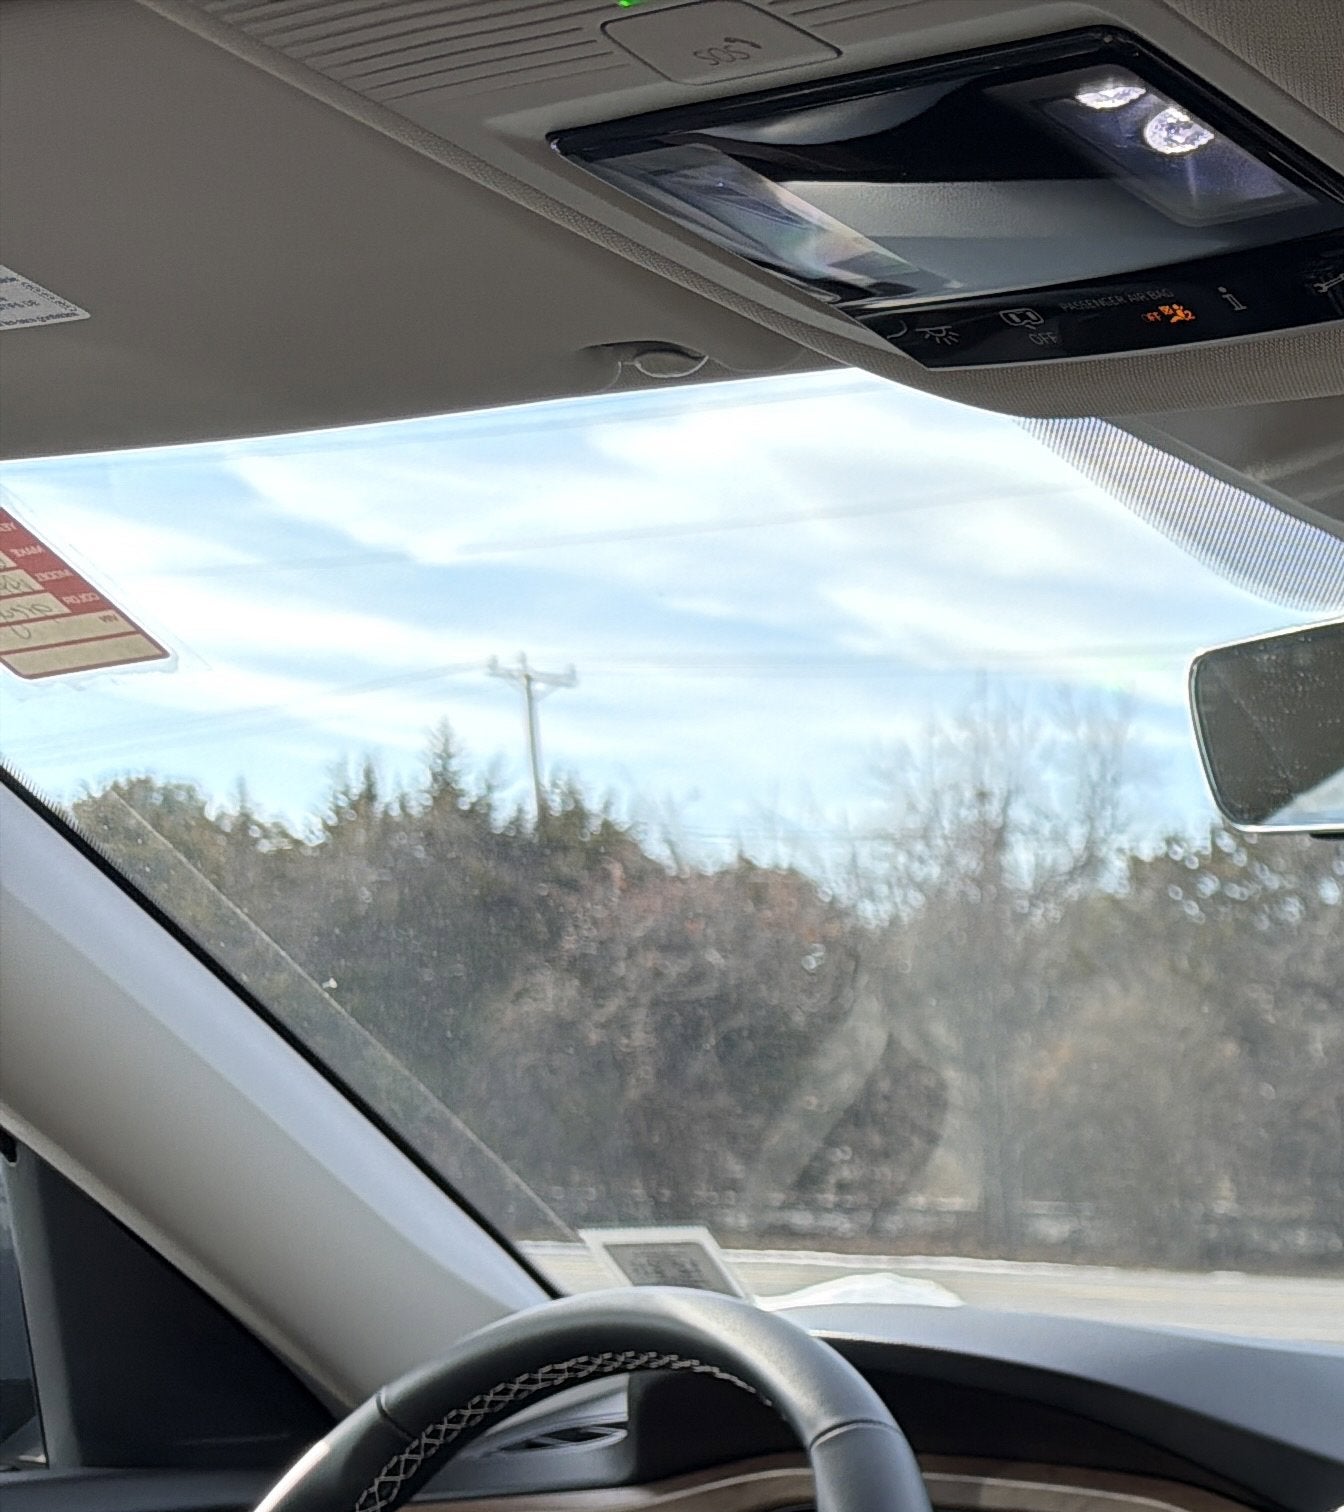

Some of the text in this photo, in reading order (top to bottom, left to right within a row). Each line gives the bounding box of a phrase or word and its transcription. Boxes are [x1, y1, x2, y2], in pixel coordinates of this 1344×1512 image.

[693, 44, 750, 65] SOS
[1059, 288, 1176, 312] PASSENGER AIR BAG
[1029, 331, 1059, 346] OFF
